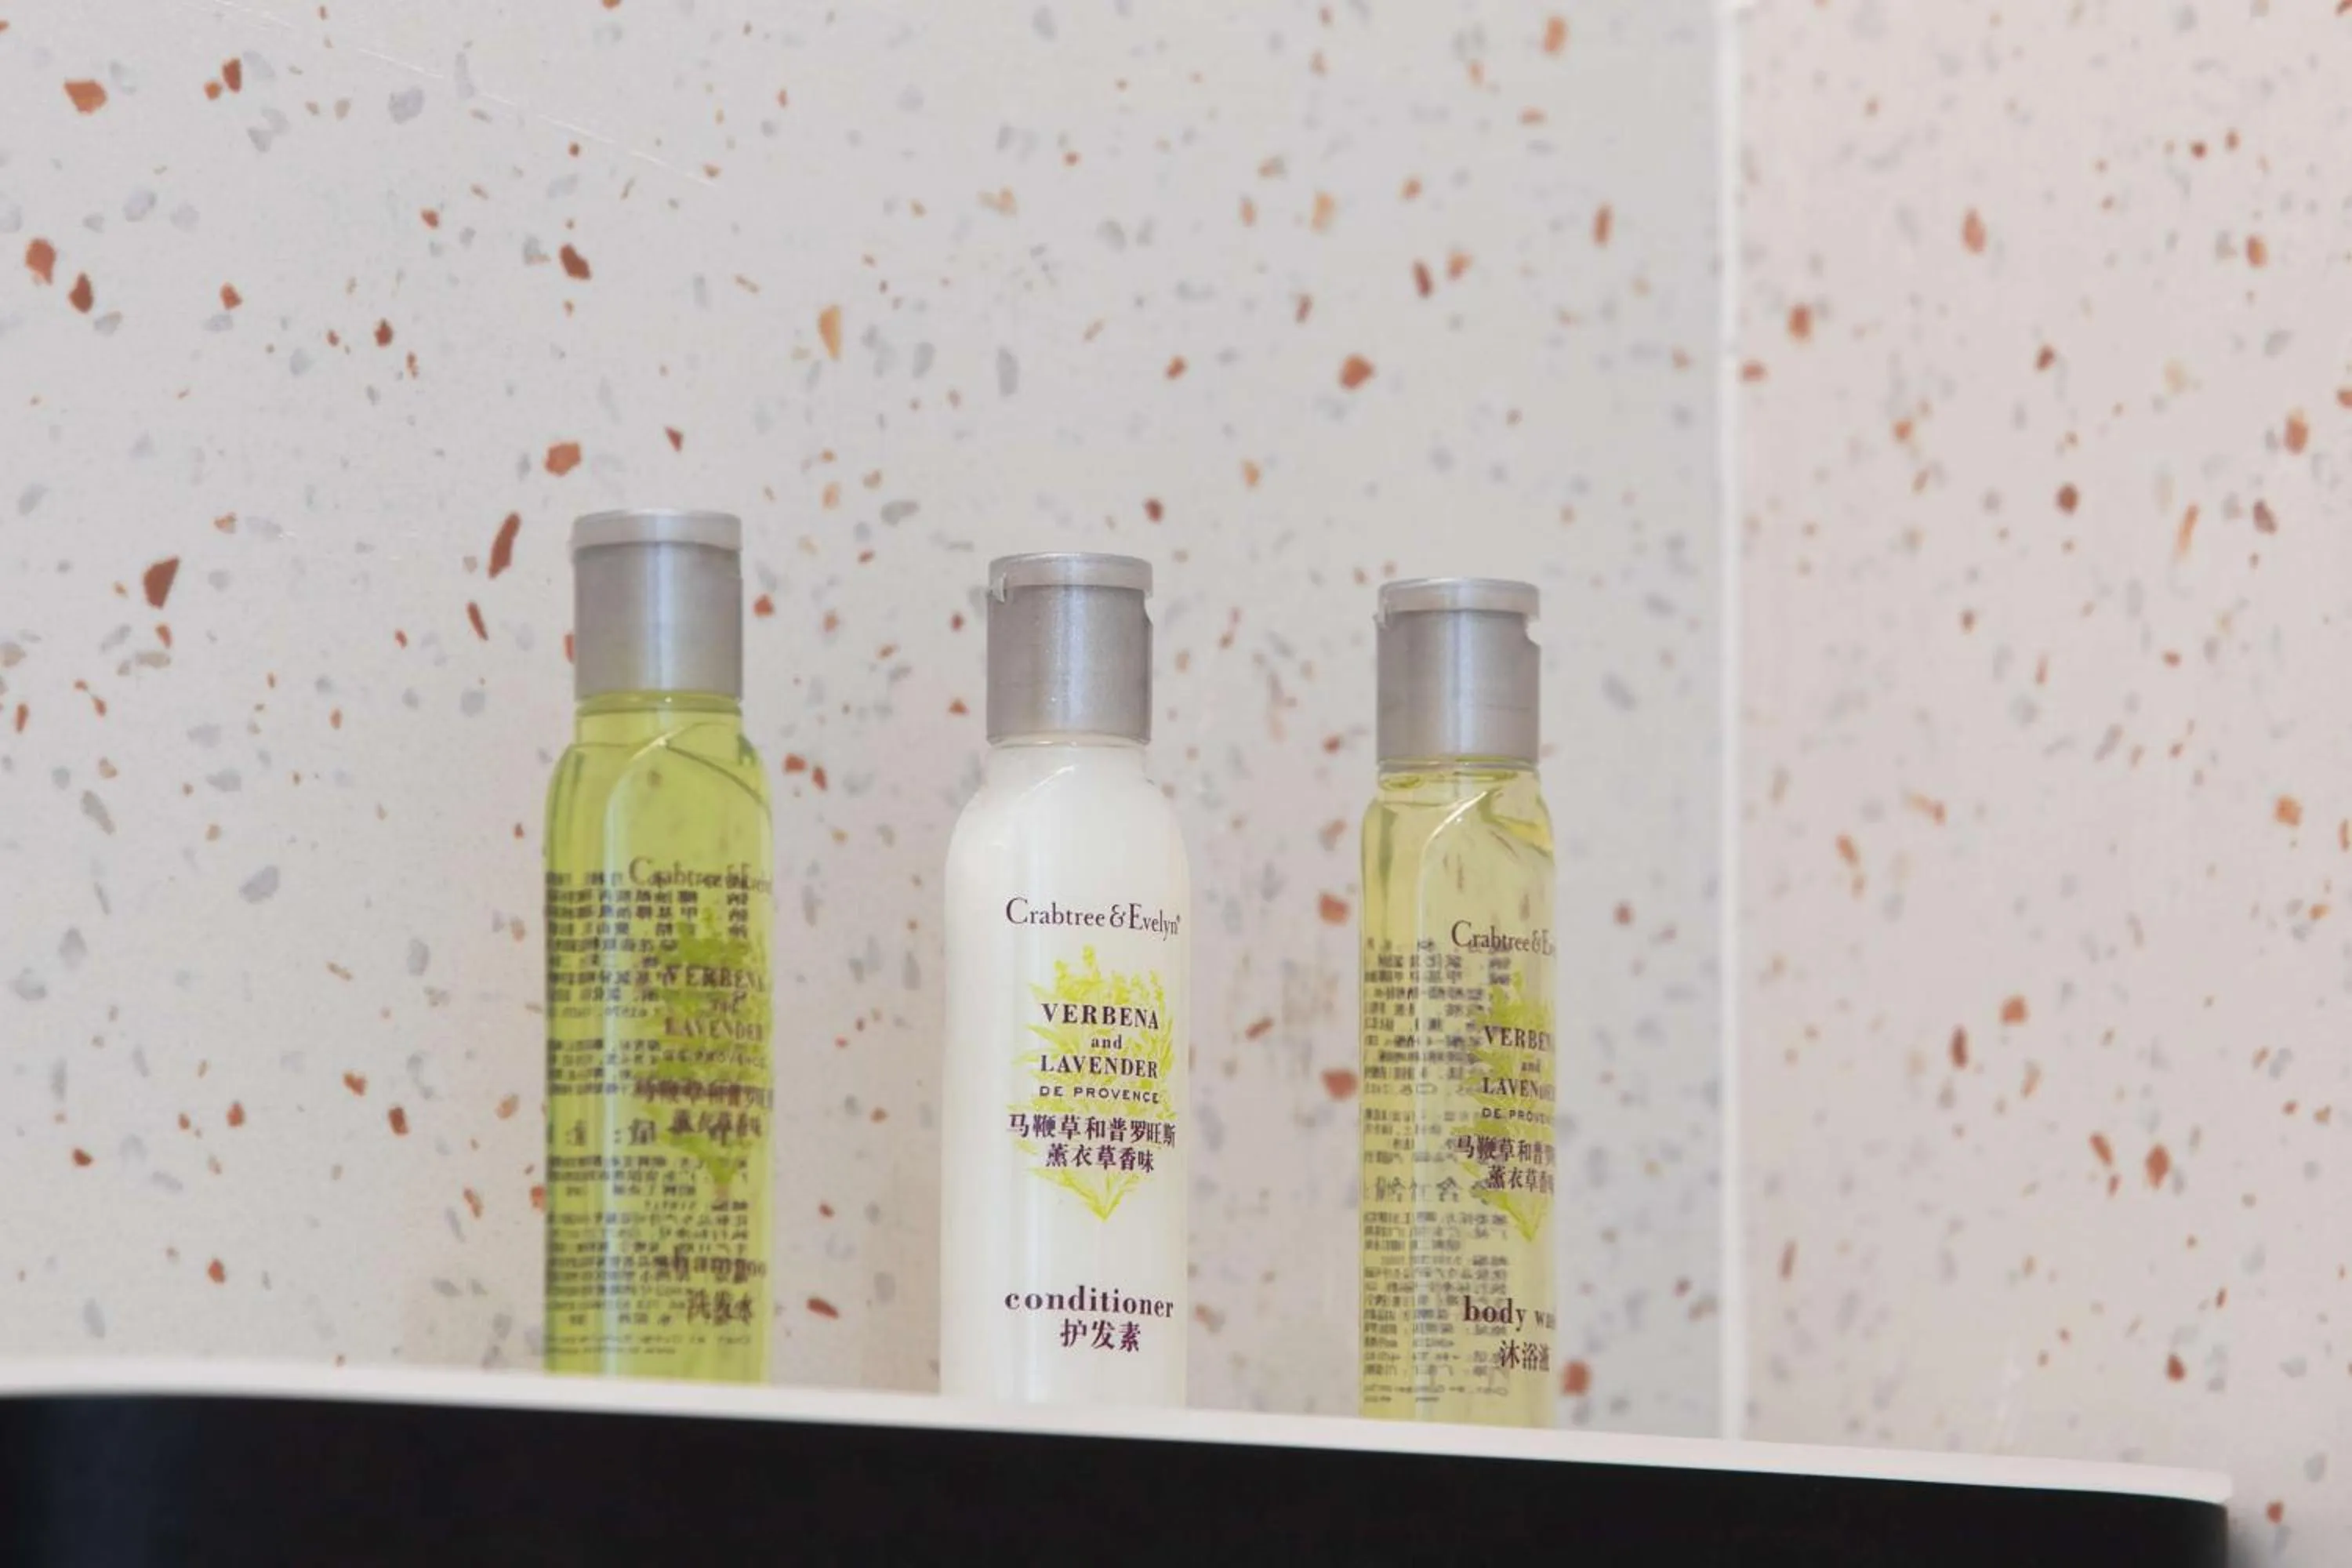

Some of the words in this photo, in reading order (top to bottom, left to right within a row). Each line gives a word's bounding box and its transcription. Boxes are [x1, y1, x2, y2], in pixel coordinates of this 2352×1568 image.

[1005, 896, 1105, 927] Crabtree
[1451, 920, 1530, 952] Crabtree
[1040, 1003, 1159, 1029] VERBENA
[1091, 1035, 1122, 1050] and
[1040, 1055, 1158, 1079] LAVENDER
[1039, 1086, 1064, 1097] DE
[1073, 1086, 1160, 1105] PROVENCE
[1482, 1108, 1501, 1119] DE
[1008, 1113, 1176, 1148] 马鞭草和普罗旺斯
[1004, 1285, 1174, 1318] conditioner
[1462, 1294, 1527, 1332] body
[1060, 1319, 1141, 1352] 护发素
